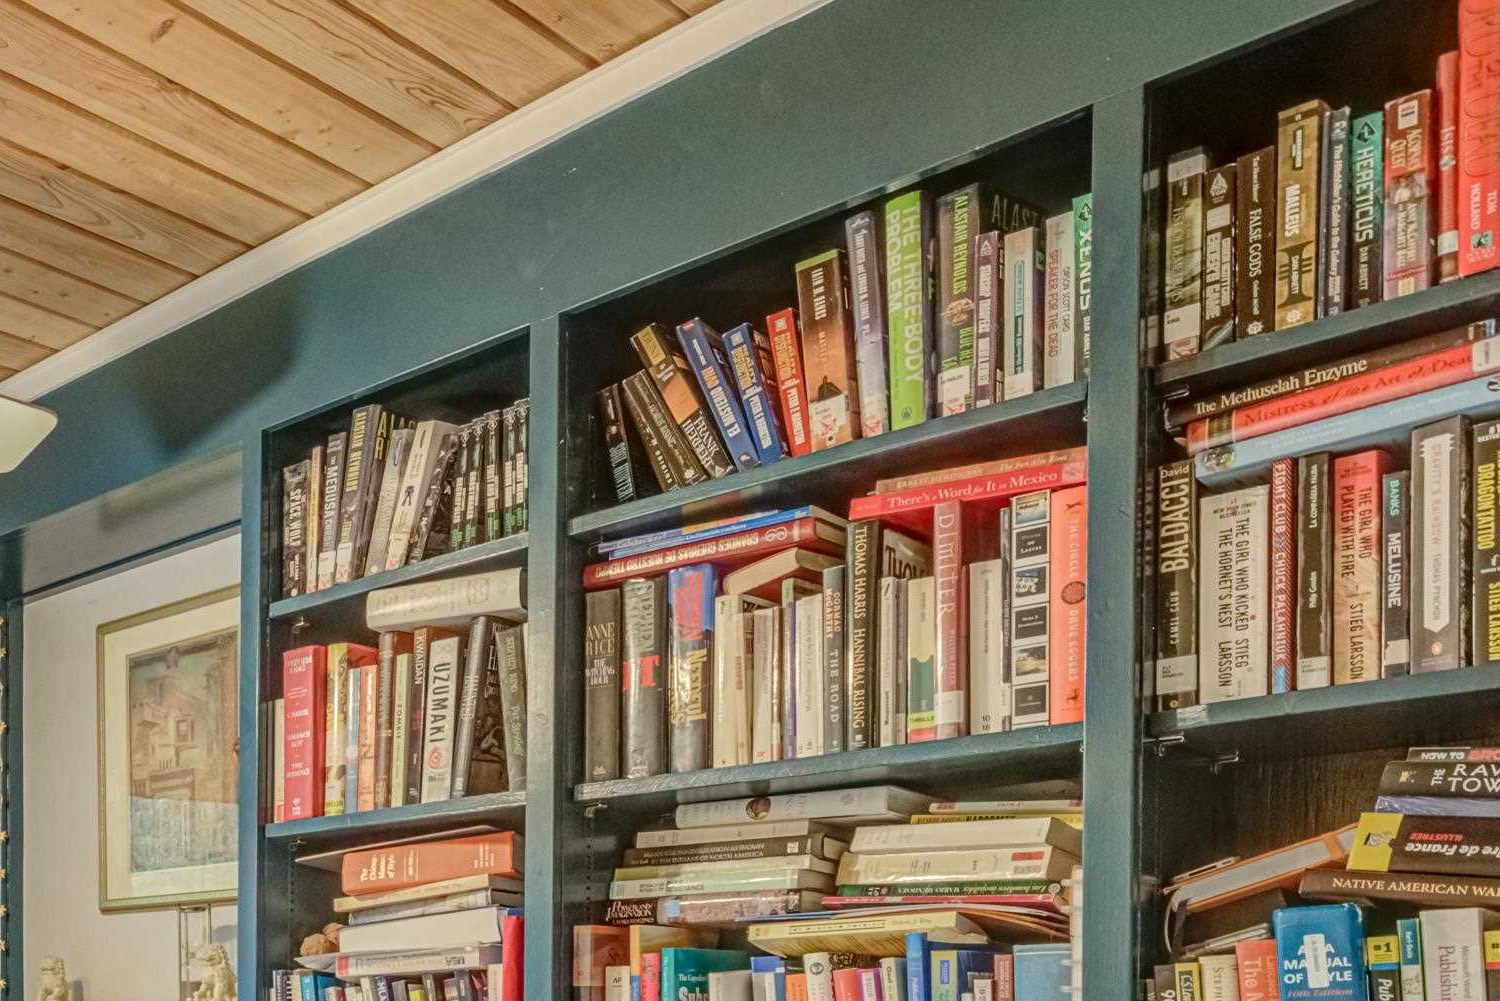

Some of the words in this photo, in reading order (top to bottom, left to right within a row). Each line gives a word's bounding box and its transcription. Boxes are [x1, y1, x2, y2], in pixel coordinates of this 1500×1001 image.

[1284, 184, 1301, 237] MALLEUS
[1355, 148, 1374, 242] HERETICUS
[903, 204, 919, 246] THE
[1249, 208, 1262, 242] FALSE
[886, 210, 902, 312] PROBLEM
[1048, 250, 1058, 290] SPEAKER
[1249, 244, 1262, 277] GODS
[904, 254, 923, 384] THREE-BODY
[1048, 292, 1058, 310] FOR
[1048, 312, 1058, 330] THE
[1048, 332, 1058, 357] DEAD
[1196, 401, 1217, 415] The
[1220, 377, 1300, 410] Methuselah
[1303, 358, 1367, 387] Enzyme
[352, 412, 367, 448] ALASTAIR
[694, 419, 718, 456] FRANK
[346, 450, 362, 492] REYNOLDS
[1161, 465, 1189, 480] David
[1478, 464, 1495, 508] DRAGON
[288, 488, 302, 519] SPACE
[324, 465, 338, 518] MEDUSA
[1341, 486, 1355, 524] PLAYED
[1358, 487, 1372, 506] THE
[1390, 480, 1400, 516] BANKS
[288, 522, 302, 548] WOLF
[1161, 478, 1189, 572] BALDACCI
[1218, 528, 1232, 548] THE
[1236, 518, 1249, 537] THE
[1342, 526, 1355, 551] WITH
[1358, 509, 1372, 532] GIRL
[1477, 510, 1494, 548] TATTOO
[855, 526, 868, 575] THOMAS
[1236, 540, 1249, 563] GIRL
[1358, 534, 1372, 558] WHO
[939, 513, 958, 617] DIMITER
[1218, 551, 1232, 600] HORNET'S
[1236, 568, 1249, 591] WHO
[1341, 554, 1356, 577] FIRE
[1387, 532, 1402, 608] MELUSINE
[854, 578, 867, 620] HARRIS
[1218, 604, 1232, 628] NEST
[1236, 594, 1249, 630] KICKED
[1350, 603, 1364, 631] STIEG
[414, 636, 426, 684] KWAIDAN
[506, 636, 518, 670] STEPHEN
[830, 650, 839, 678] THE
[854, 629, 866, 685] HANNIBAL
[1218, 640, 1232, 686] LARSSON
[1236, 640, 1249, 668] STIEG
[1350, 634, 1364, 680] LARSSON
[509, 672, 518, 694] KING
[428, 662, 452, 742] UZUMAKI
[830, 684, 840, 722] ROAD
[854, 689, 864, 729] RISING
[1431, 768, 1446, 786] THE
[1405, 842, 1457, 856] France
[1460, 844, 1480, 856] de
[1243, 957, 1260, 988] The
[1284, 972, 1303, 984] OF
[376, 982, 389, 1001] MLA
